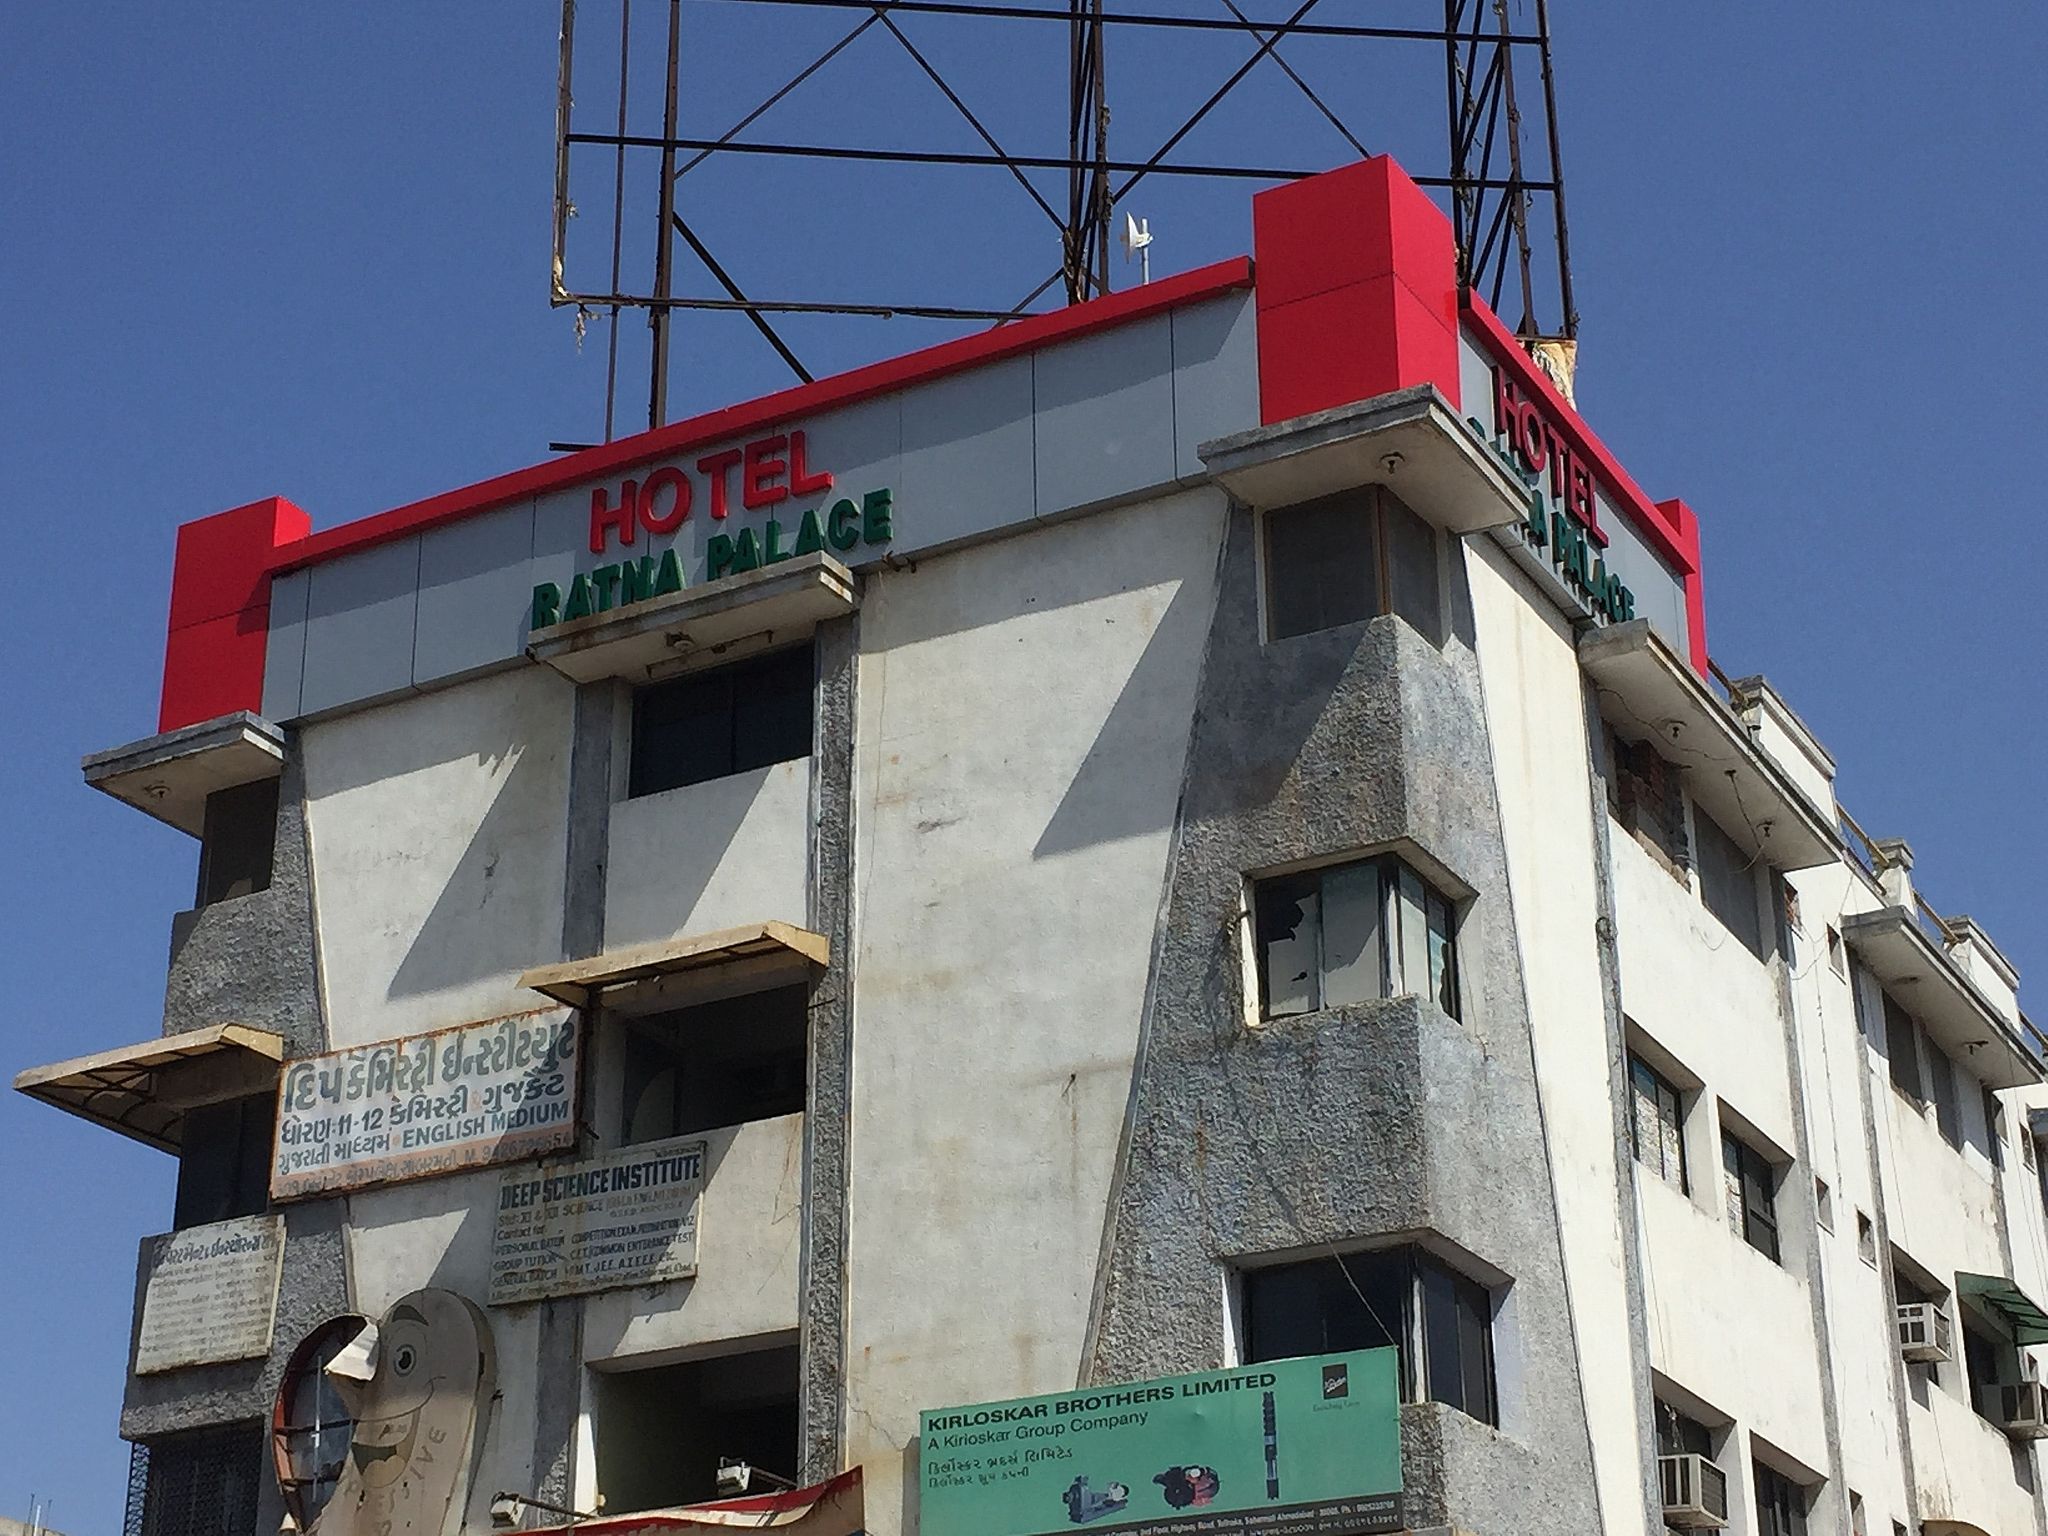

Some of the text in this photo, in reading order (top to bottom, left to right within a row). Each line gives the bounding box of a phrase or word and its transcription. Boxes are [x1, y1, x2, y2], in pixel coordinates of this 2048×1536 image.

[589, 430, 834, 553] HOTEL
[1491, 365, 1609, 548] HOTEL
[532, 487, 893, 630] RATNA PALACE
[1551, 511, 1635, 623] PALACE
[402, 1116, 485, 1148] ENGLISH
[491, 1100, 569, 1131] MEDIUM
[500, 1181, 541, 1210] DEEP
[543, 1168, 610, 1203] SCIENCE
[611, 1153, 700, 1191] INSTITUTE
[928, 1373, 1277, 1432] KIRLOSKAR BROTHERS LIMITED
[928, 1438, 940, 1451] A
[1016, 1422, 1065, 1440] Group
[1070, 1411, 1148, 1433] Company
